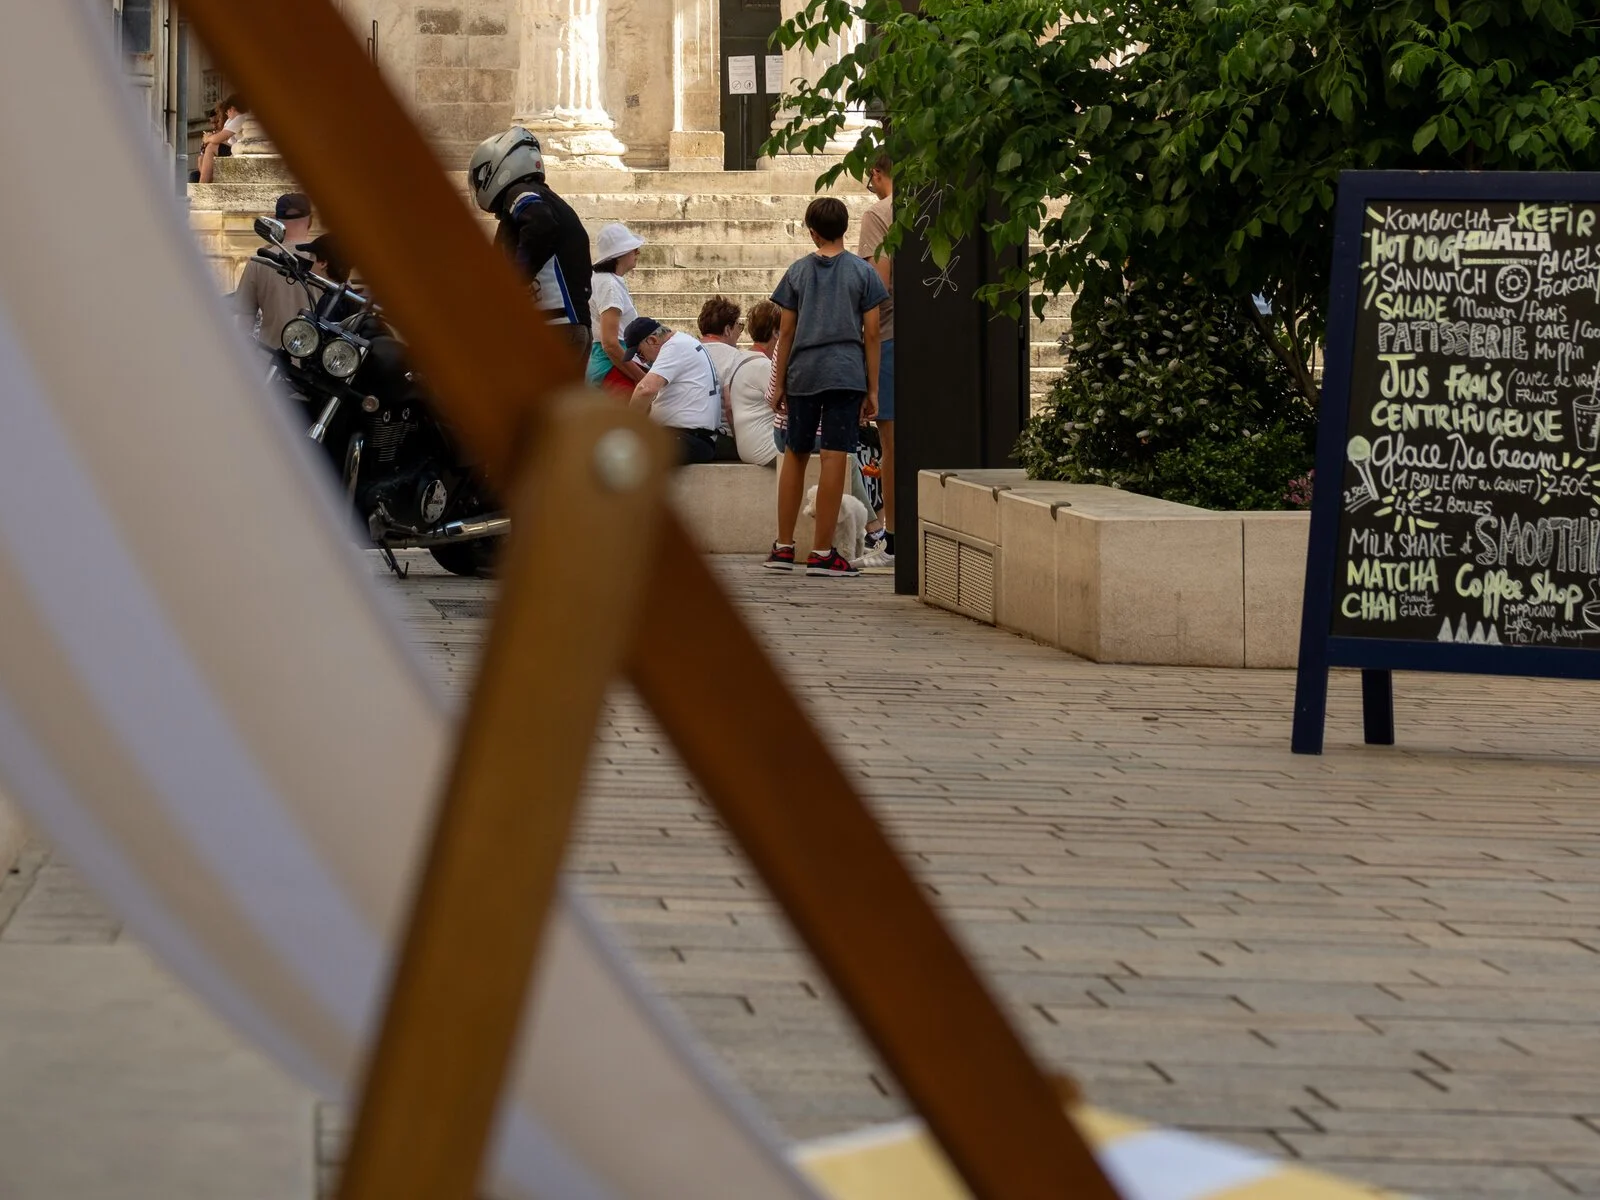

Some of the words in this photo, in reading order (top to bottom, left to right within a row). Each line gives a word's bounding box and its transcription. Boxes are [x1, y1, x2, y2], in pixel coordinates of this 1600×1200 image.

[1384, 205, 1491, 231] KOMBUCHA
[1371, 227, 1410, 268] HOT
[1455, 224, 1552, 252] LAVAZZA
[1375, 292, 1450, 322] SALADE
[1395, 469, 1408, 490] 1
[1410, 471, 1451, 490] BOULE
[1446, 495, 1493, 516] BOULES
[1399, 532, 1457, 558] SHAKE
[1347, 557, 1440, 594] MATCHA
